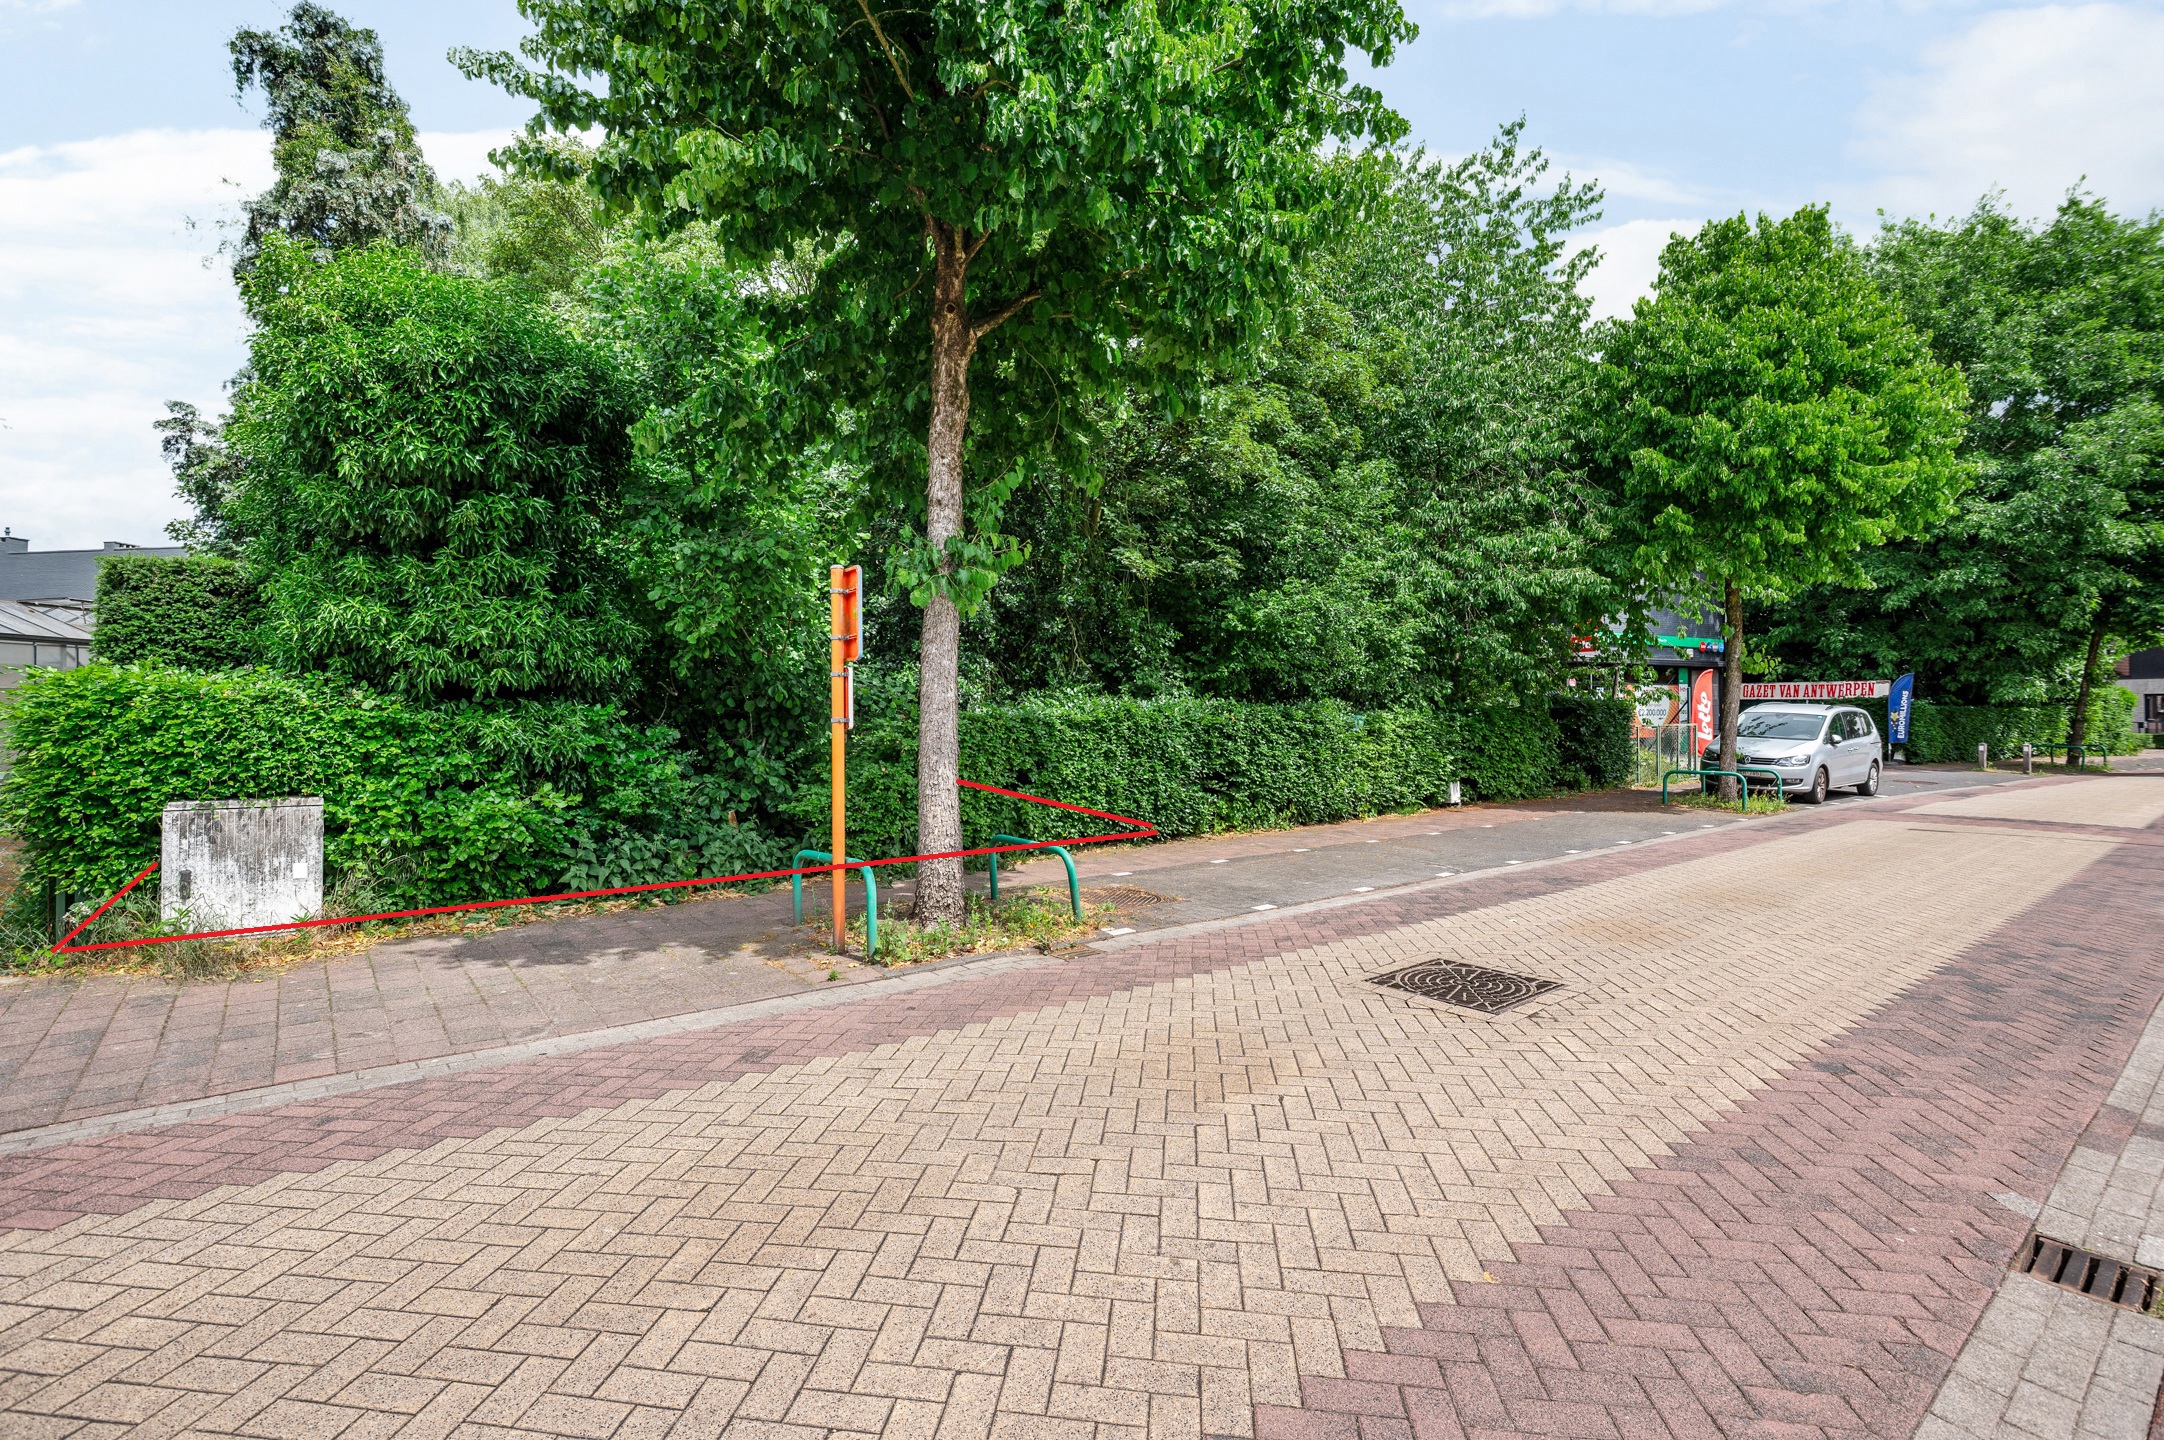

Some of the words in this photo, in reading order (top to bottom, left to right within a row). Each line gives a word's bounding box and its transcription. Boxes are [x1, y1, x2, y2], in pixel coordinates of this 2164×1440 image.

[1742, 684, 1776, 698] GAZET
[1779, 684, 1801, 698] VAN
[1803, 682, 1876, 698] ANTWERPEN
[1897, 690, 1909, 739] EUROMILLIONS
